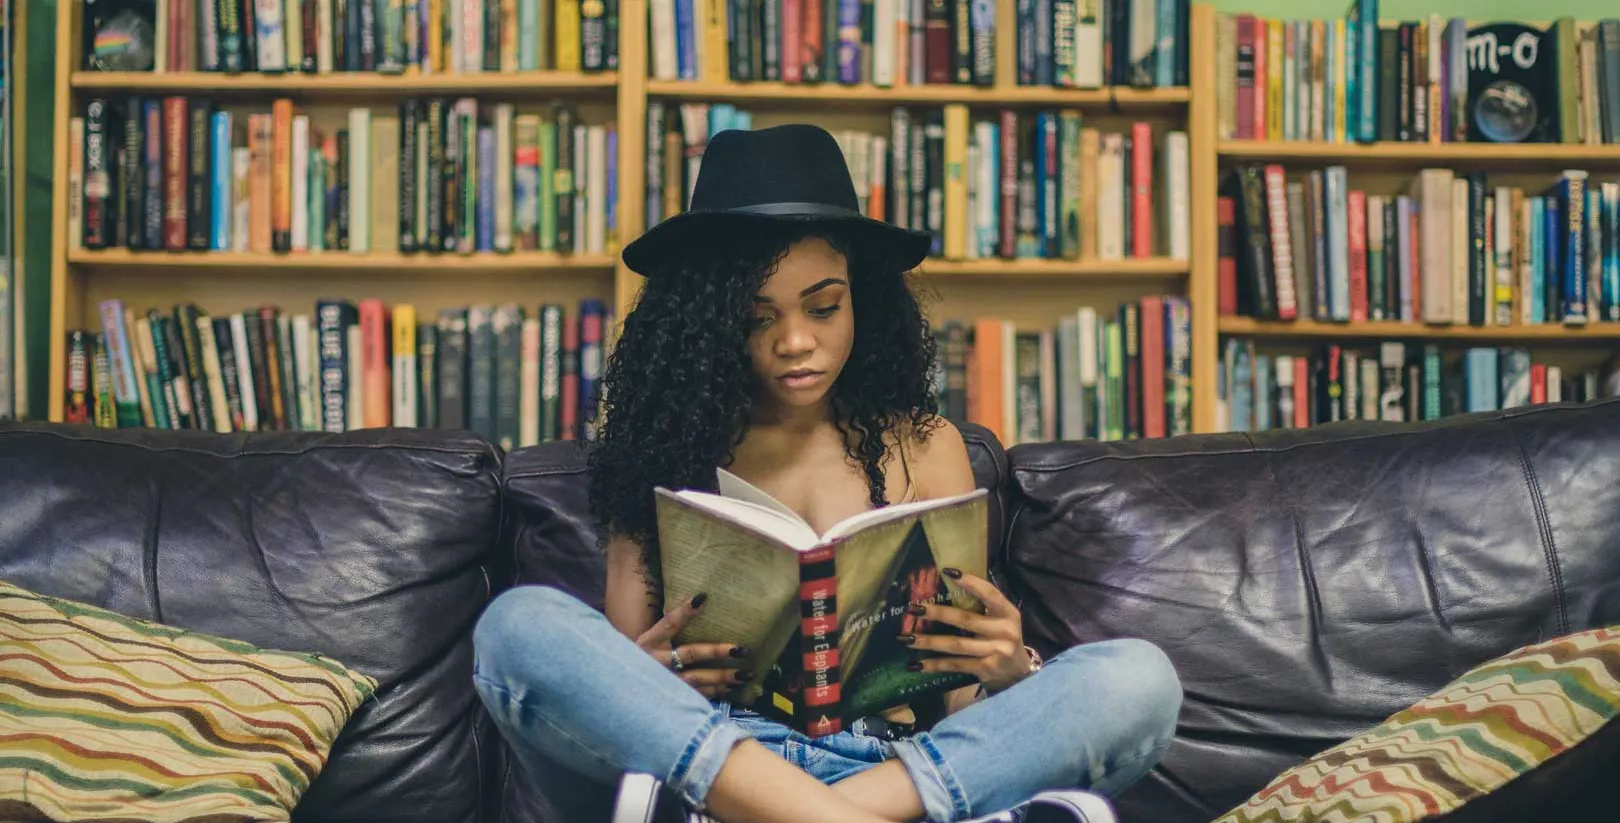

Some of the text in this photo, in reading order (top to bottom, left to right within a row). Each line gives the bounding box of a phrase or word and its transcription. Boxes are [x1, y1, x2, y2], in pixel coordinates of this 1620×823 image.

[320, 304, 342, 360] BLUE
[811, 588, 830, 698] Water for Elephants
[851, 611, 886, 631] Water
[890, 605, 904, 617] for
